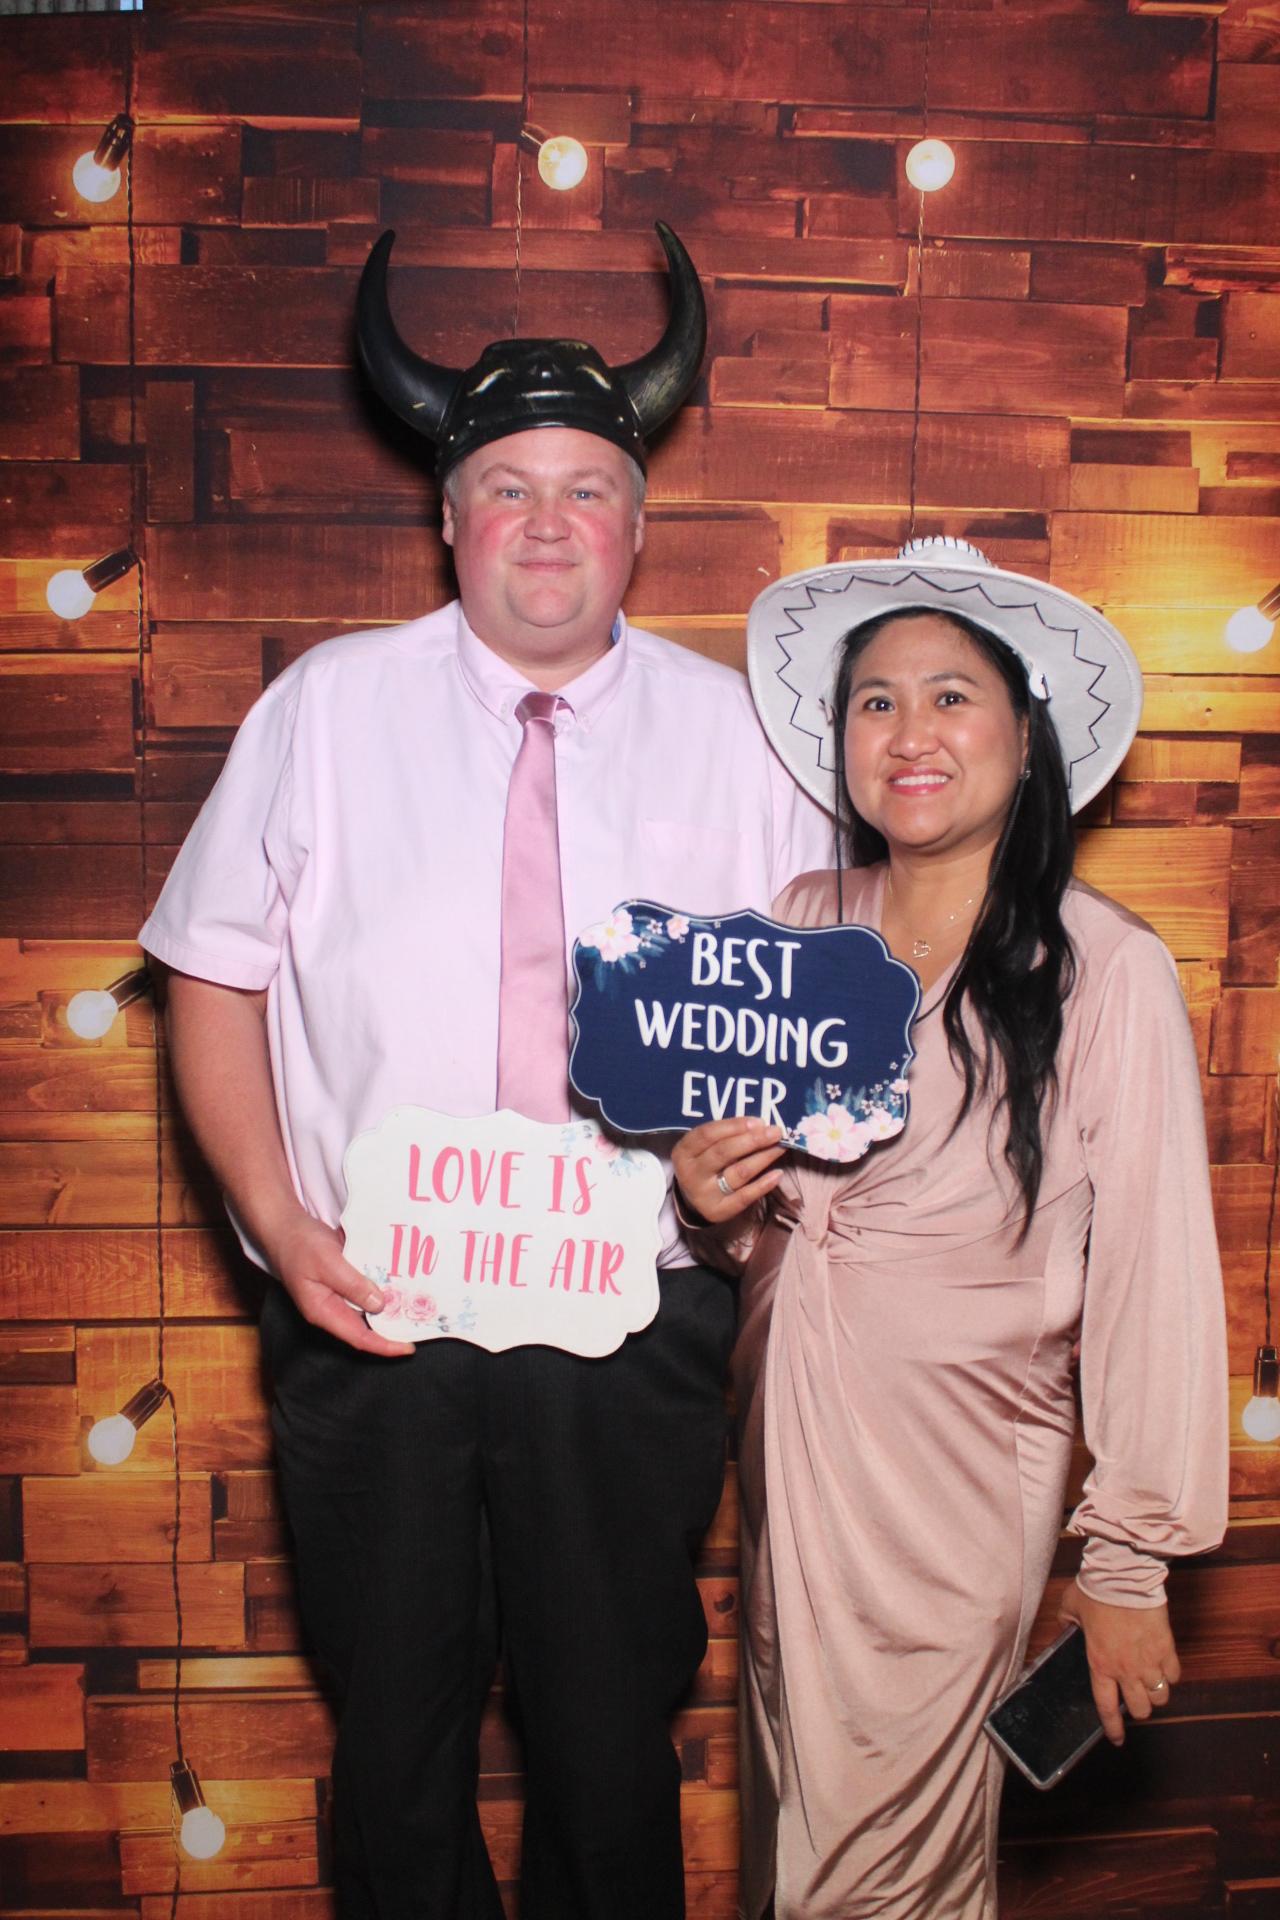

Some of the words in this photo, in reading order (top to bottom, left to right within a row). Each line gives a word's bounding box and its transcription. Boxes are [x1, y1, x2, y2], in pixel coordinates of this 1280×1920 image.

[691, 932, 802, 1000] BEST
[634, 998, 849, 1068] WEDDING
[681, 1070, 789, 1139] EVER
[408, 1143, 525, 1209] LOVE
[547, 1154, 598, 1215] IS
[459, 1230, 534, 1287] THE
[549, 1238, 625, 1295] AIR
